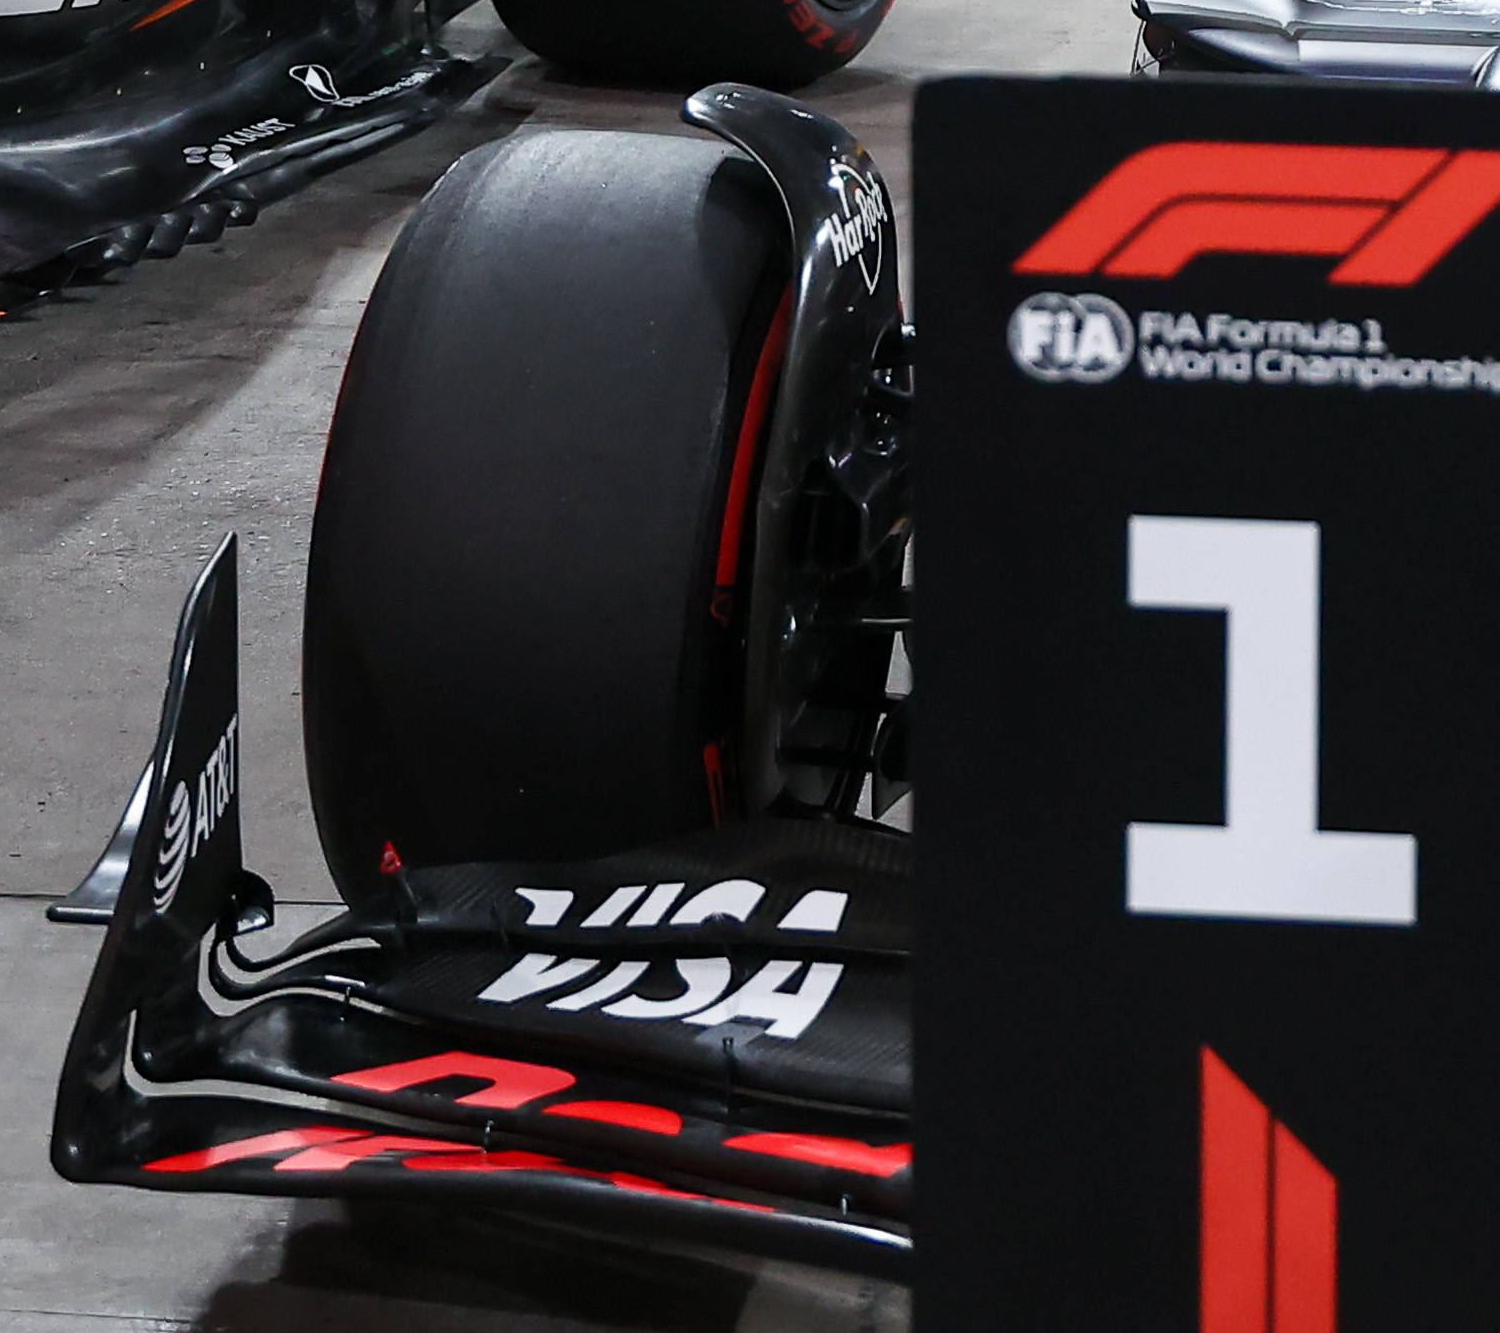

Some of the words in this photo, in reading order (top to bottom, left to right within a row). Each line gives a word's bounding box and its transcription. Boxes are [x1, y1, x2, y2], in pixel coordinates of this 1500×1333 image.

[1139, 312, 1205, 345] FIA
[1209, 314, 1362, 352] Formula
[1365, 319, 1384, 351] 1
[1142, 345, 1252, 382] World
[1125, 514, 1418, 926] 1
[190, 711, 238, 859] AT&T
